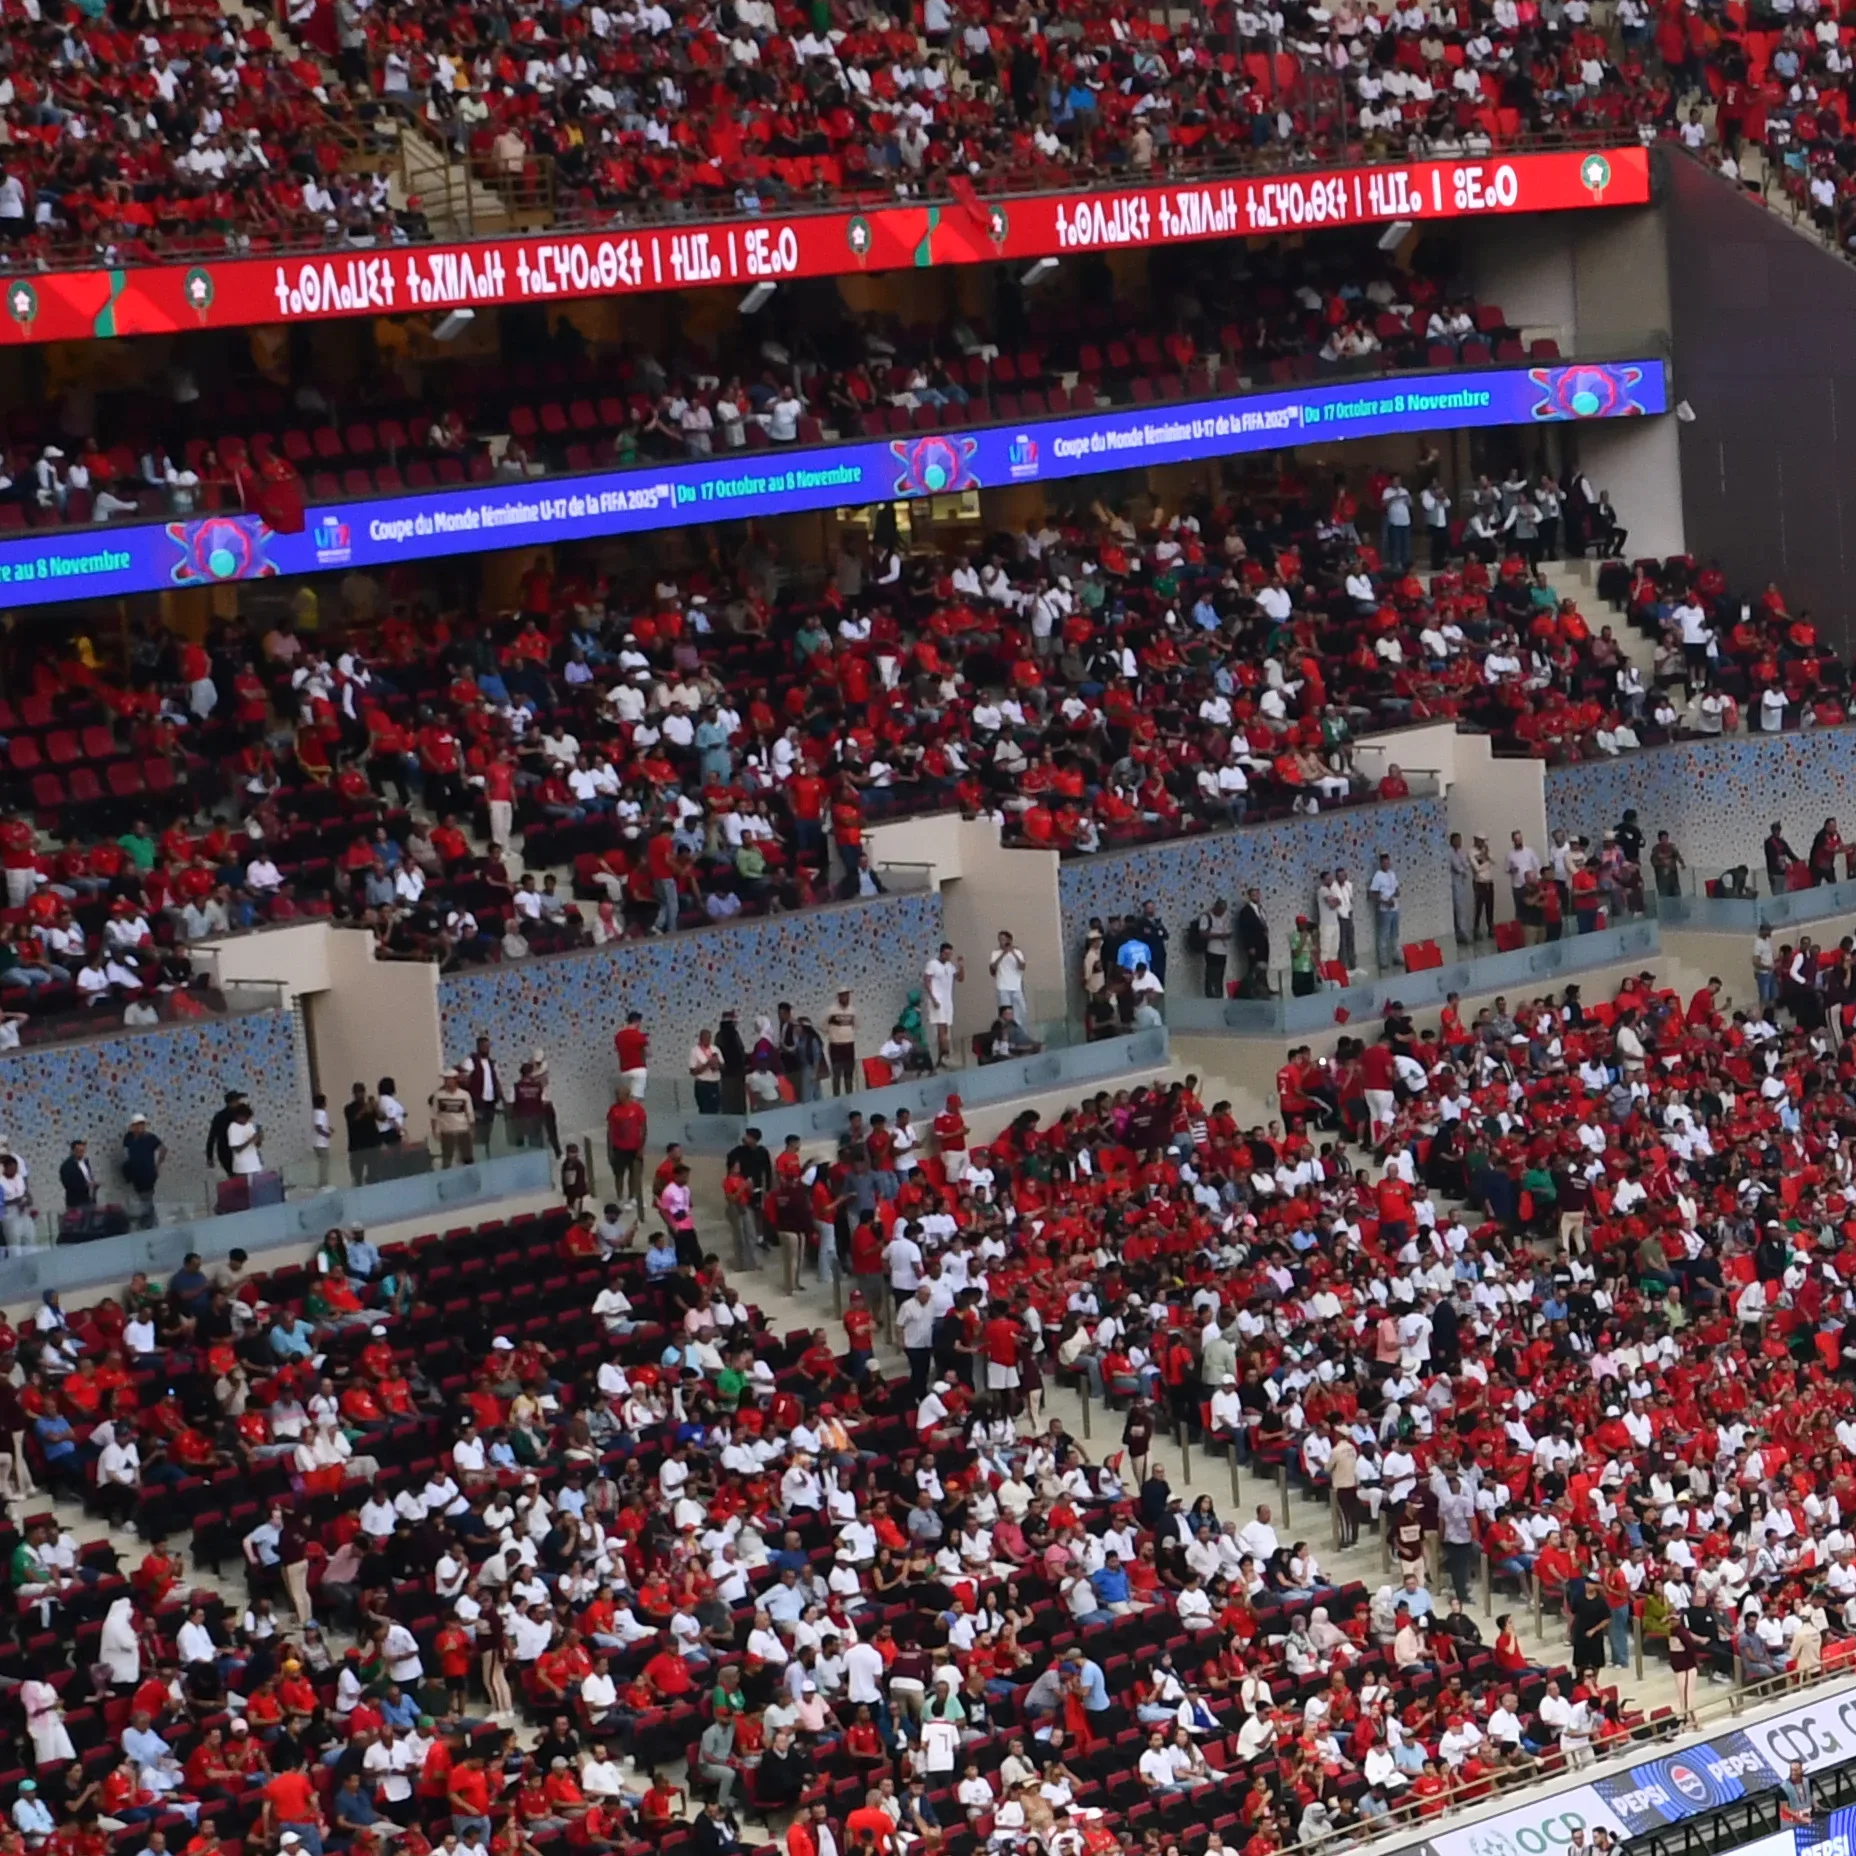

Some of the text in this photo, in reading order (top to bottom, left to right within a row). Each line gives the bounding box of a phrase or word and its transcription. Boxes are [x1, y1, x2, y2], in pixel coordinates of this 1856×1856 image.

[1053, 437, 1090, 459] Coupe
[1091, 431, 1106, 452] du
[1106, 426, 1144, 450] Monde
[1215, 415, 1230, 435] de
[1230, 413, 1241, 433] la
[1241, 411, 1264, 432] FIFA
[1304, 405, 1320, 423] Du
[1324, 403, 1334, 421] 17
[1336, 399, 1377, 419] Octobre
[1379, 398, 1393, 412] au
[1394, 395, 1405, 412] 8
[1407, 389, 1490, 411] Novembre
[370, 518, 413, 543] Coupe
[415, 513, 433, 536] du
[434, 507, 480, 533] Monde
[568, 495, 585, 517] de
[586, 494, 600, 516] la
[601, 489, 628, 513] FIFA
[676, 484, 696, 503] Du
[700, 481, 715, 501] 17
[716, 474, 766, 499] Octobre
[768, 476, 784, 492] au
[785, 472, 795, 490] 8
[796, 464, 861, 488] Novembre
[15, 562, 35, 581] au
[50, 549, 131, 577] Novembre
[1766, 1717, 1842, 1764] CDG
[1707, 1749, 1765, 1783] PEPSI
[1611, 1783, 1670, 1817] PEPSI
